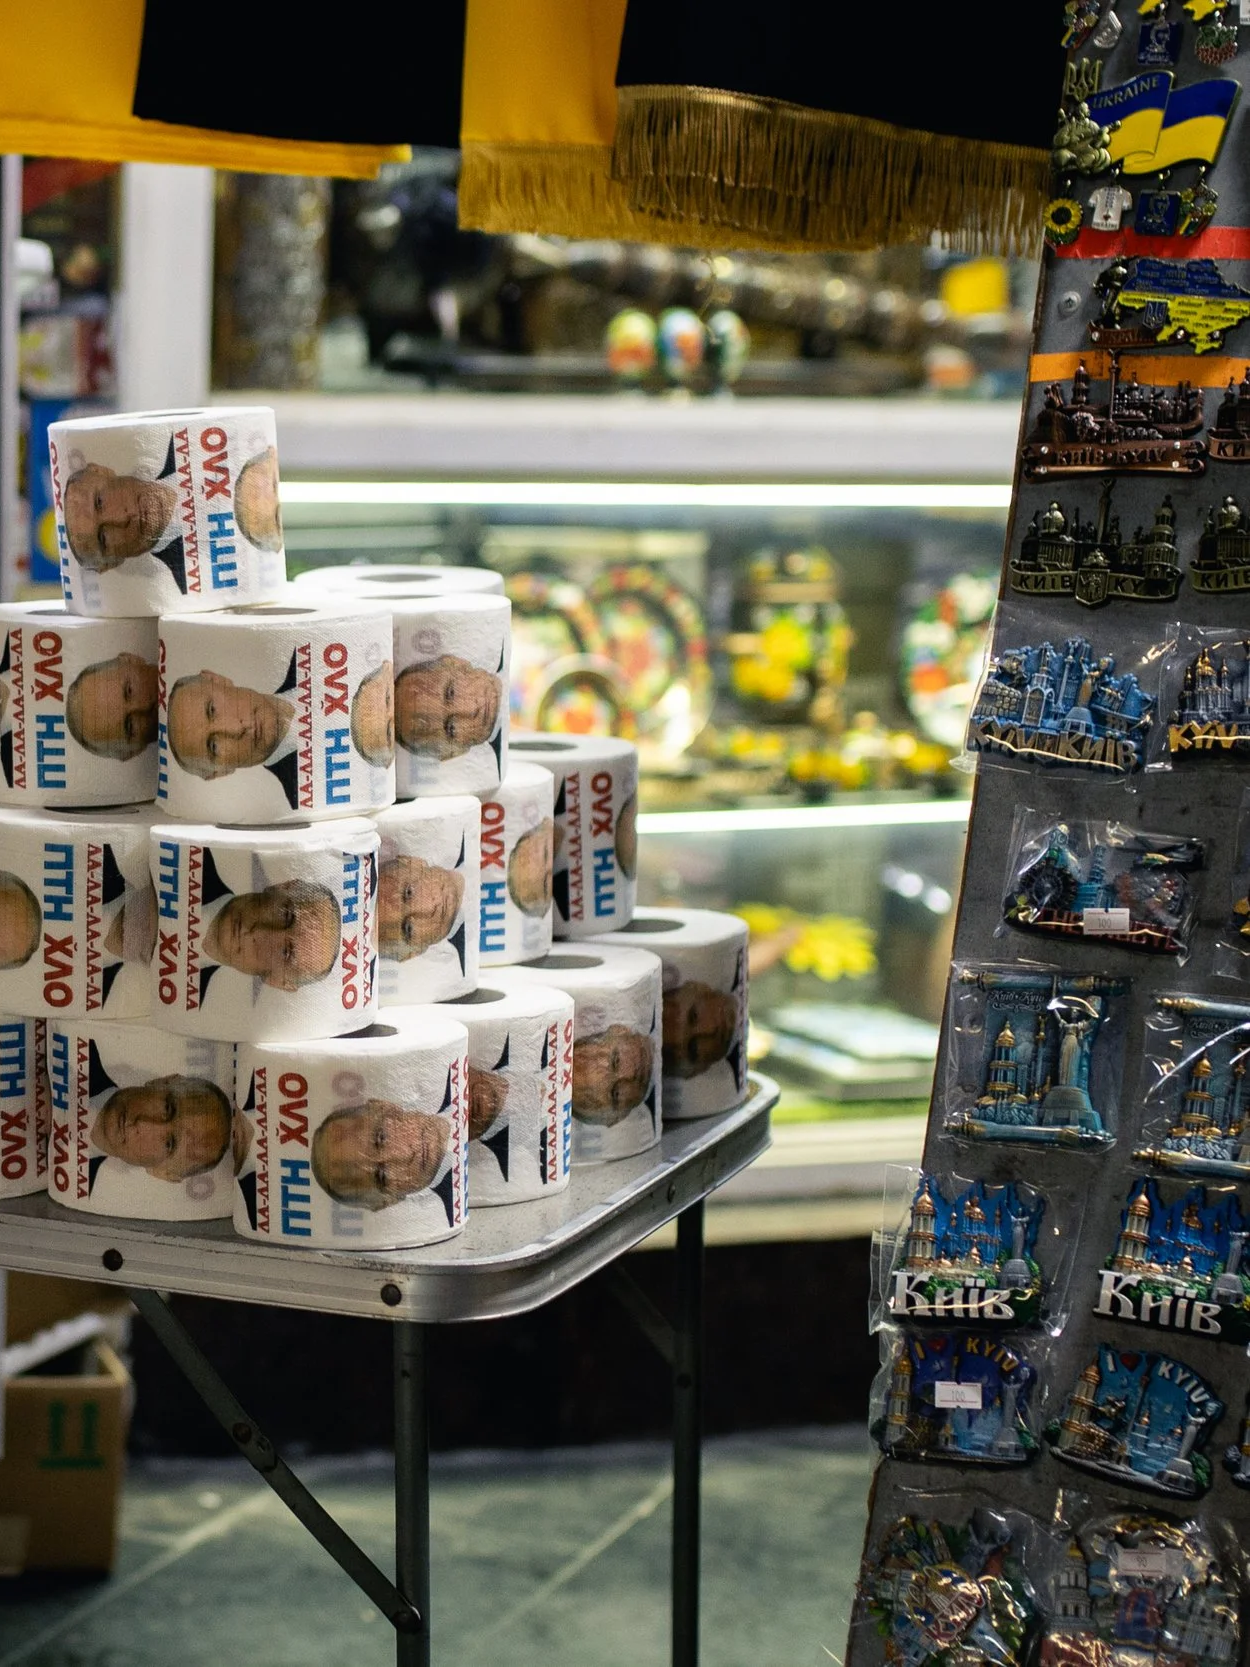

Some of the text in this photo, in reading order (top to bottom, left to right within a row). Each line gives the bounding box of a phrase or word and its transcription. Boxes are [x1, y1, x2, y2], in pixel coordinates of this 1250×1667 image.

[1092, 75, 1160, 109] UKRAINE
[207, 510, 238, 590] ПТН
[1019, 573, 1074, 588] КИЇВ
[35, 714, 67, 789] ПТН
[324, 727, 351, 805] ПТН
[1168, 719, 1239, 753] KYIV
[43, 843, 75, 922] ПТН
[158, 841, 180, 920] ПТН
[479, 880, 506, 953] ПТН
[592, 847, 616, 918] ПТН
[52, 1032, 69, 1110] ПТН
[280, 1158, 312, 1237] ПТН
[891, 1269, 1015, 1320] Київ
[1093, 1269, 1222, 1335] Київ
[914, 1340, 926, 1361] I
[1106, 1352, 1211, 1404] I KYIV
